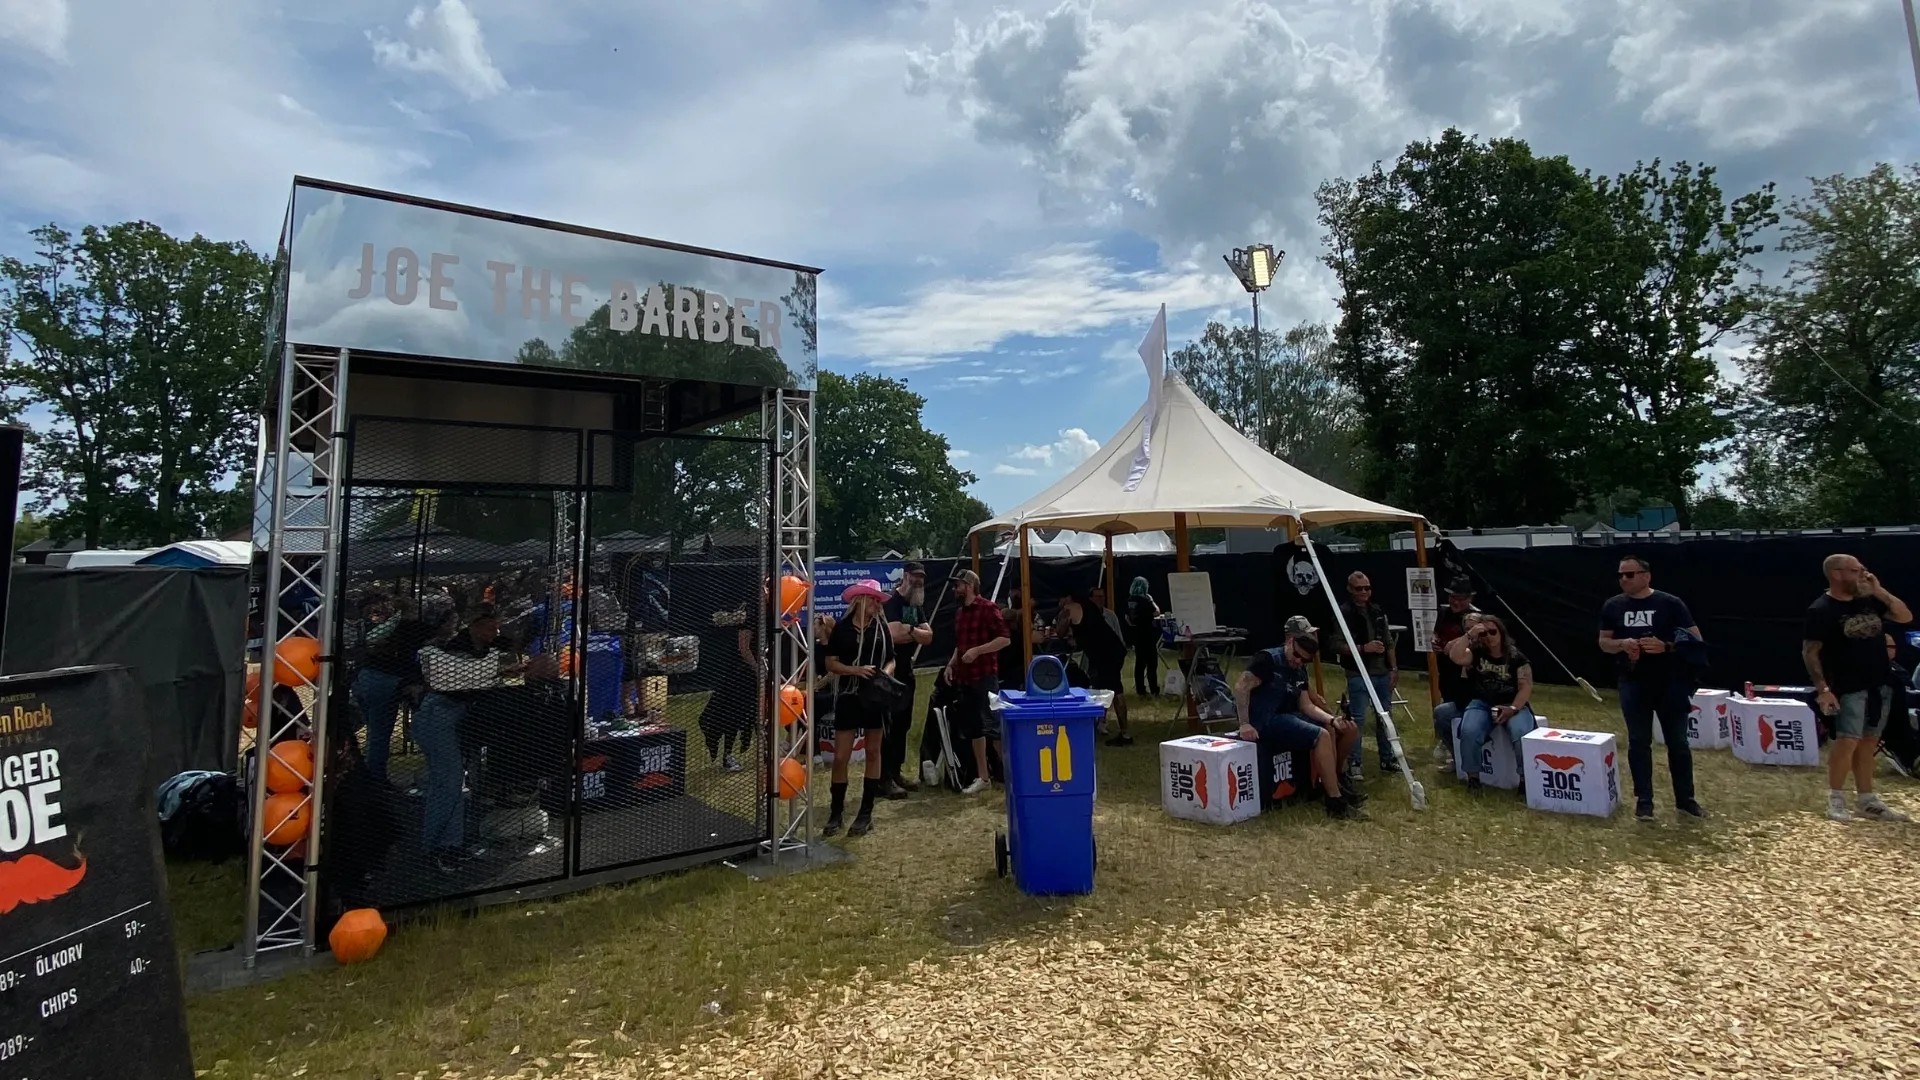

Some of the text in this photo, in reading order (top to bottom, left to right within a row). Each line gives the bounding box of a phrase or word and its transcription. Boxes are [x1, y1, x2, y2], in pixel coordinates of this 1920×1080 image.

[348, 242, 782, 350] JOE THE BARBER
[843, 568, 870, 577] Sveriges
[1623, 610, 1656, 627] CAT
[0, 702, 53, 733] n Rock
[1774, 719, 1795, 751] JOE
[1792, 720, 1805, 752] GINGER
[0, 748, 61, 789] GER
[639, 753, 672, 774] JOE
[1273, 751, 1292, 766] GINGER
[1273, 761, 1293, 783] JOE
[583, 770, 606, 790] JO
[1170, 761, 1179, 799] GINGER
[1178, 762, 1194, 802] JOE
[1236, 765, 1248, 804] JOE
[1541, 770, 1581, 791] JOE
[1543, 788, 1582, 802] GINGER
[35, 920, 146, 976] ÖLKORV 59:-
[41, 957, 151, 1018] CHIPS 40:-
[0, 1034, 35, 1061] 289:-
